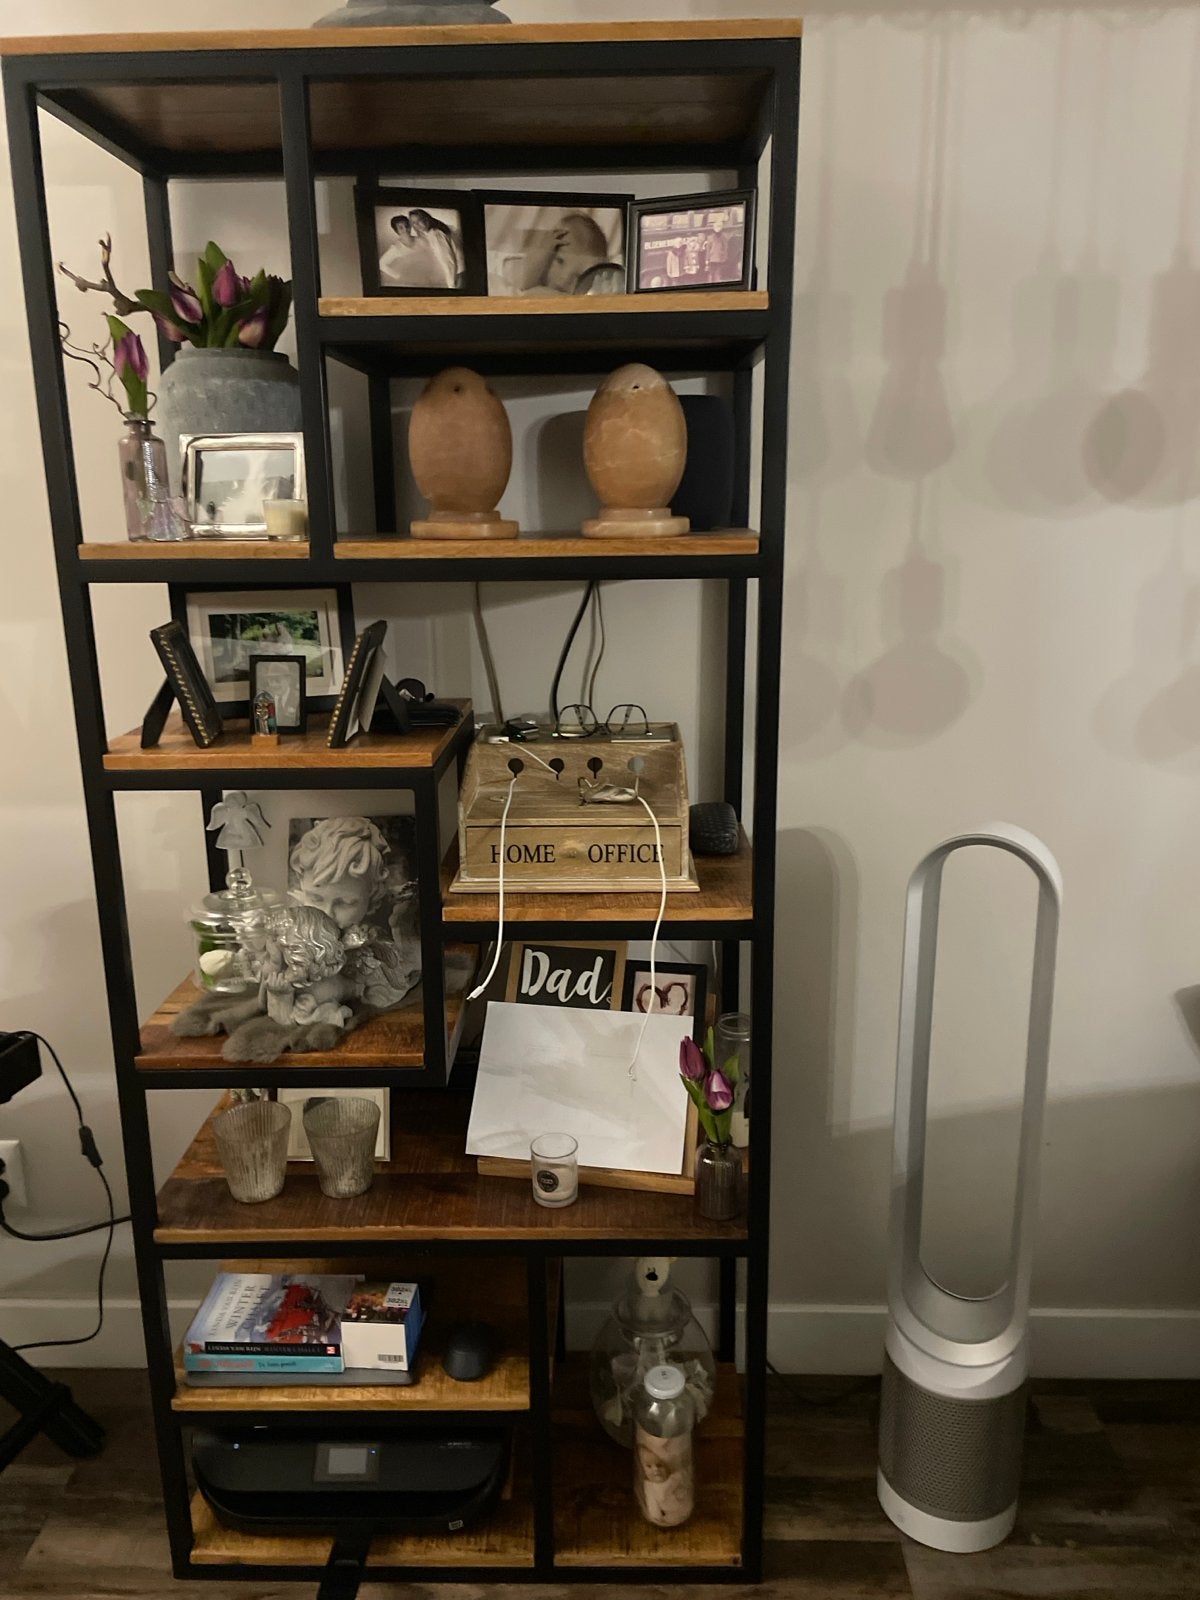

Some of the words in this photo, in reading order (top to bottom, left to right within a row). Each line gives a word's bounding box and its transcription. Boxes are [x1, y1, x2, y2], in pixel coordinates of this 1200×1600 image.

[490, 844, 556, 863] HOME
[588, 844, 664, 863] OFFICE
[521, 948, 612, 1004] Dad
[225, 1285, 256, 1329] WINTER
